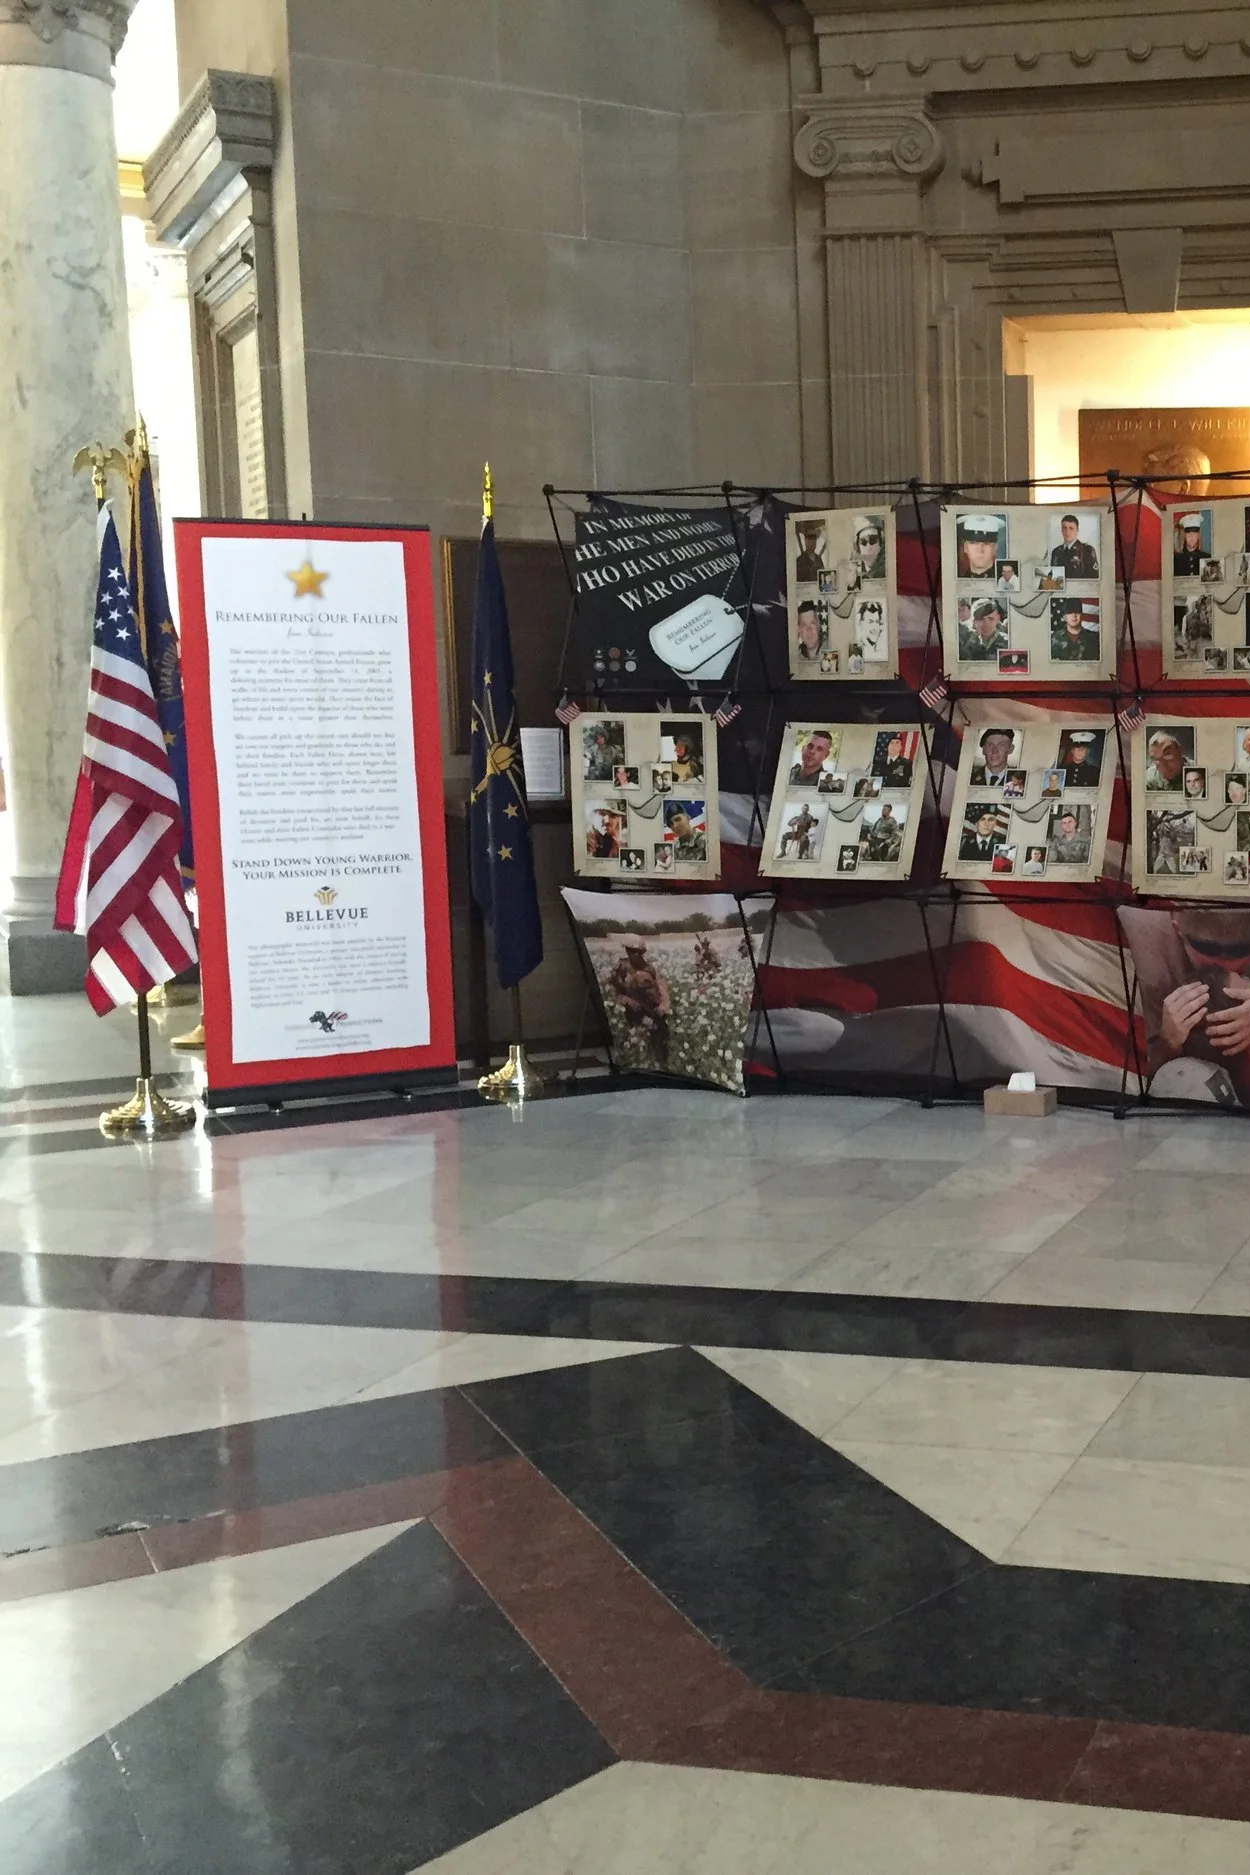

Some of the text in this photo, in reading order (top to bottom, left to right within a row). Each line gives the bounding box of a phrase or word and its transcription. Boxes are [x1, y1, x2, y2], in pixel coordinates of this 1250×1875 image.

[583, 519, 609, 535] IN
[608, 512, 677, 532] MEMORY
[575, 520, 723, 563] HE MEN AND WOMEN
[575, 565, 622, 594] HO
[620, 551, 675, 579] HAVE
[671, 542, 708, 562] DIED
[702, 537, 720, 553] IN
[617, 552, 741, 612] WAR ON TERROR
[215, 610, 399, 624] REMEMBERING OUR FALLEN
[665, 608, 712, 641] REMEMBERING
[231, 859, 271, 869] STAND
[273, 857, 312, 867] DOWN
[314, 855, 357, 865] YOUNG
[242, 870, 276, 880] YOUR
[278, 868, 327, 879] MISSION
[331, 867, 341, 877] IS
[285, 907, 369, 923] BELLEVUE
[296, 921, 359, 932] UNIVERSITY
